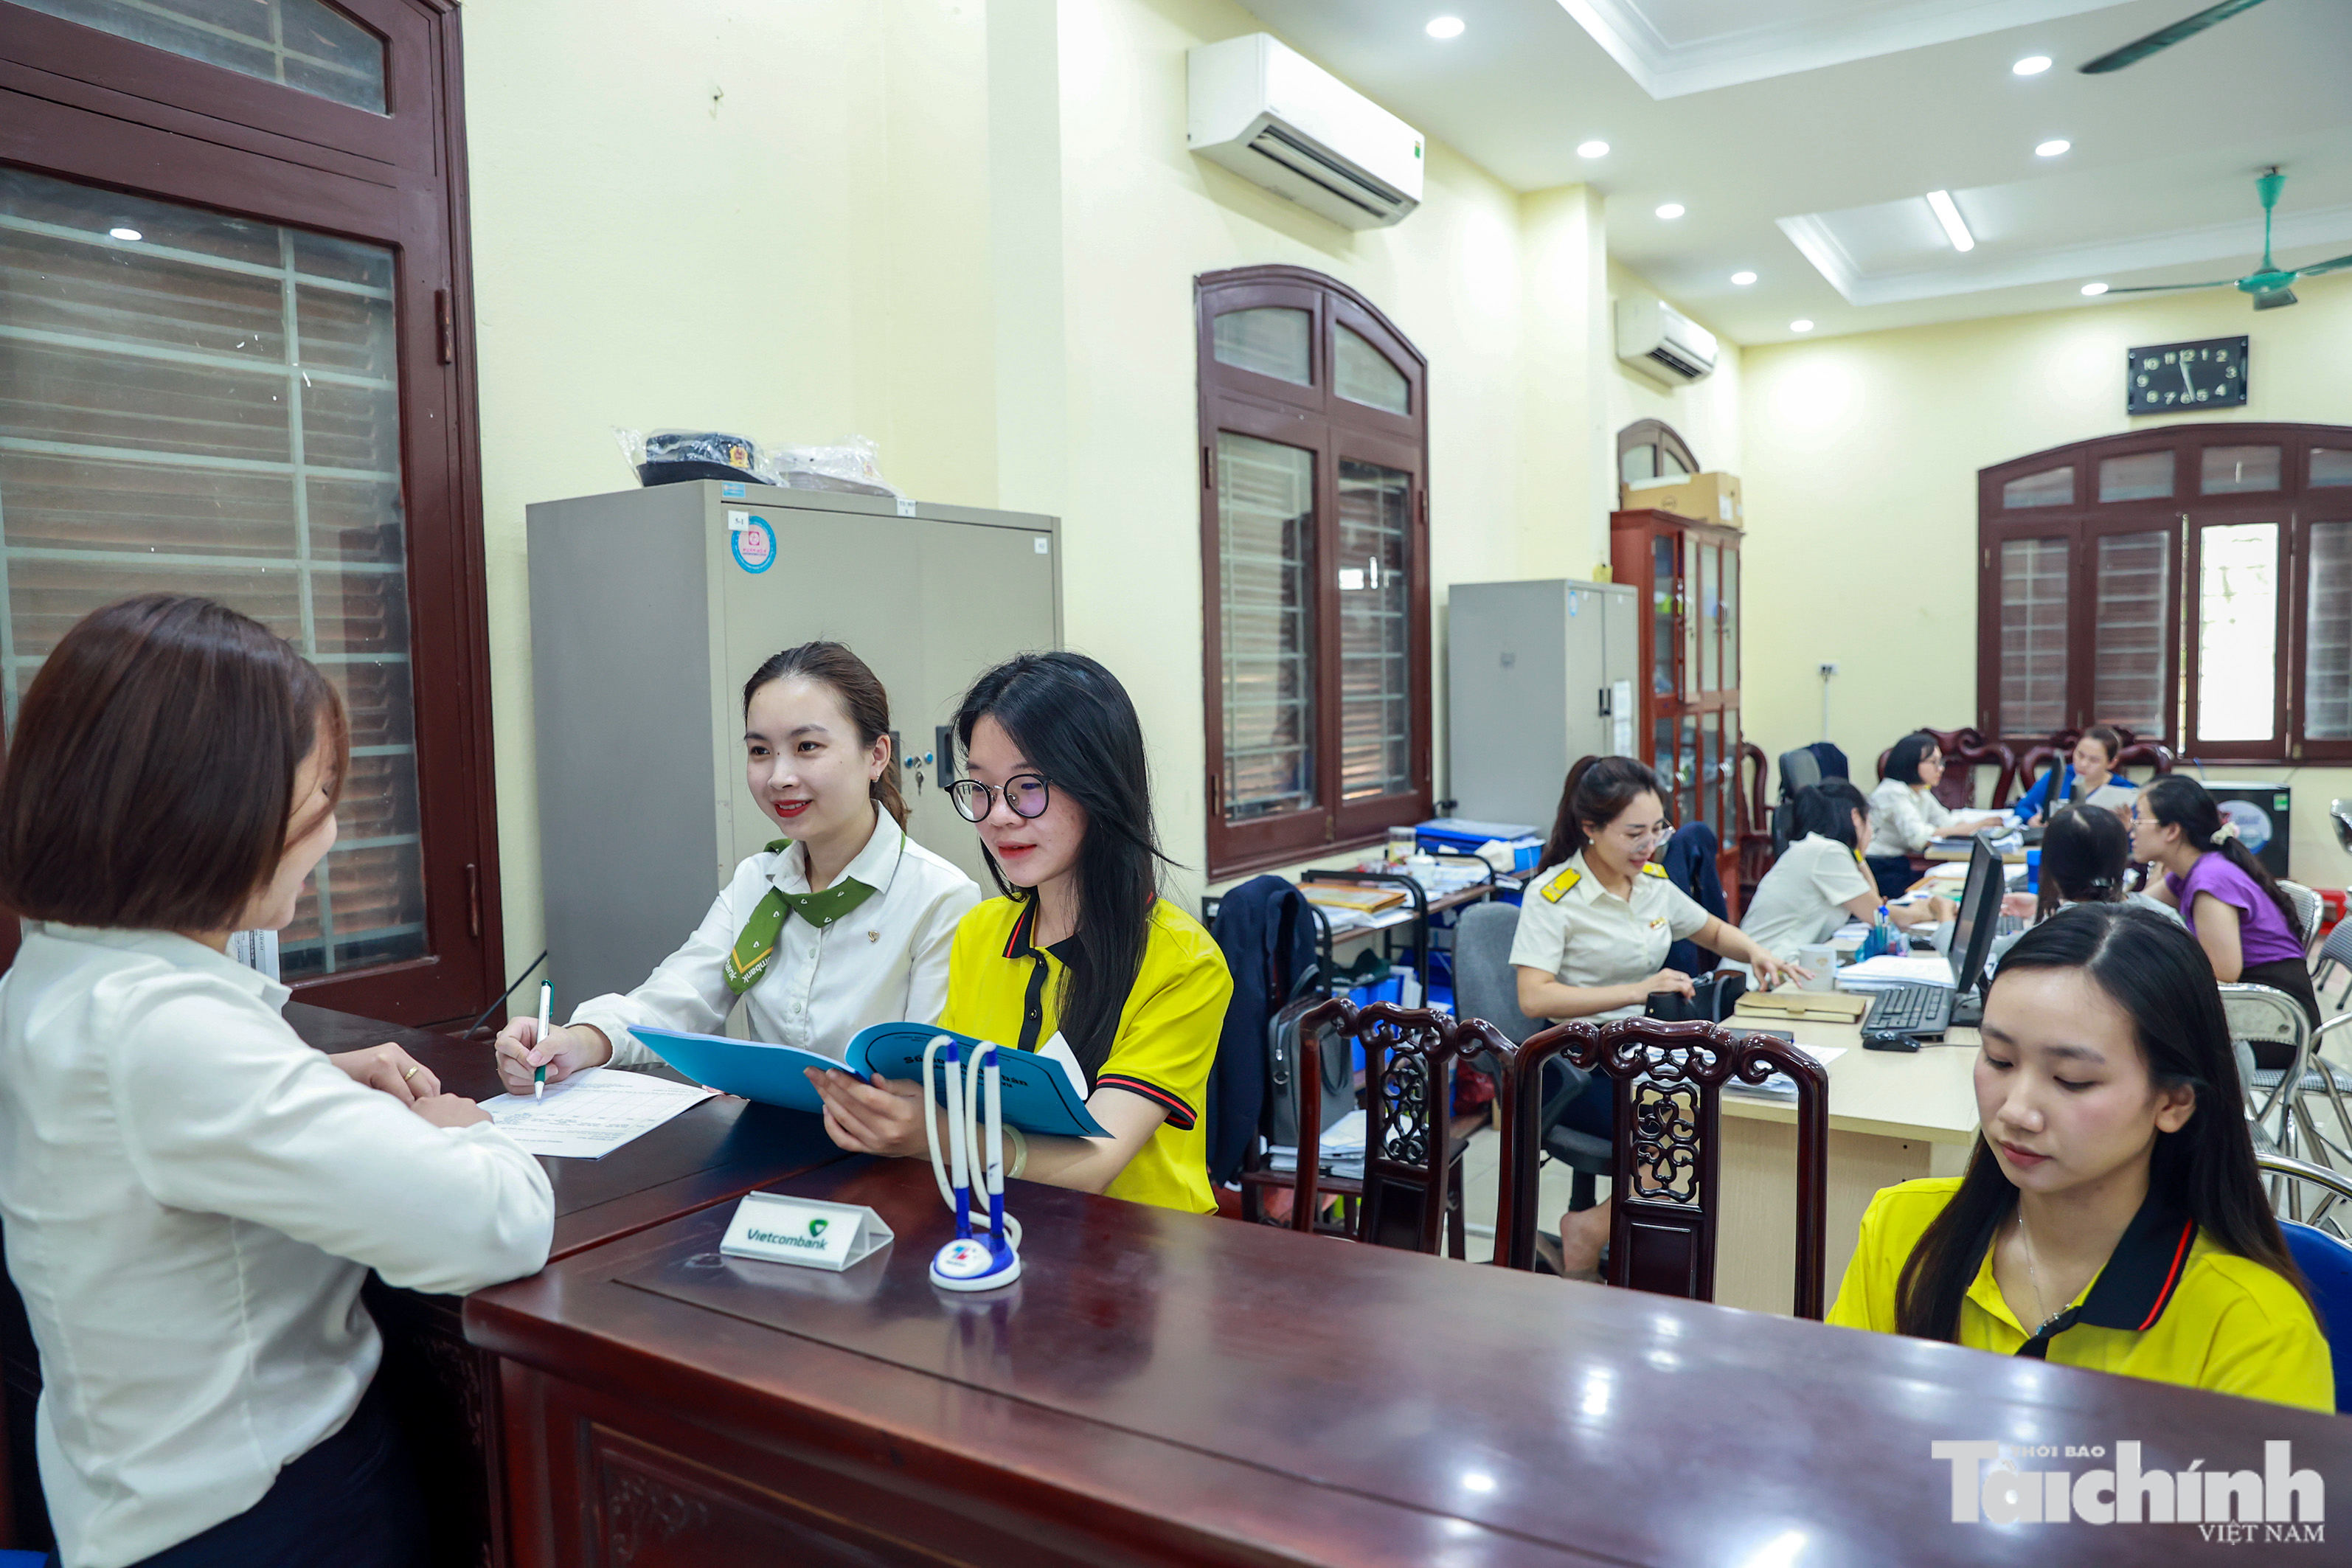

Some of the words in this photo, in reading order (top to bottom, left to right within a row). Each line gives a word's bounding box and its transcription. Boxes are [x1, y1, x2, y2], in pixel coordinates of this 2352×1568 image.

[2179, 349, 2196, 361] 12
[2201, 348, 2209, 361] 1
[2216, 349, 2228, 362] 2
[2143, 357, 2160, 370] 10
[2225, 366, 2238, 378] 3
[2196, 389, 2209, 401] 5
[2215, 384, 2227, 396] 4
[2164, 392, 2176, 405] 7
[748, 1229, 828, 1249] Vietcombank
